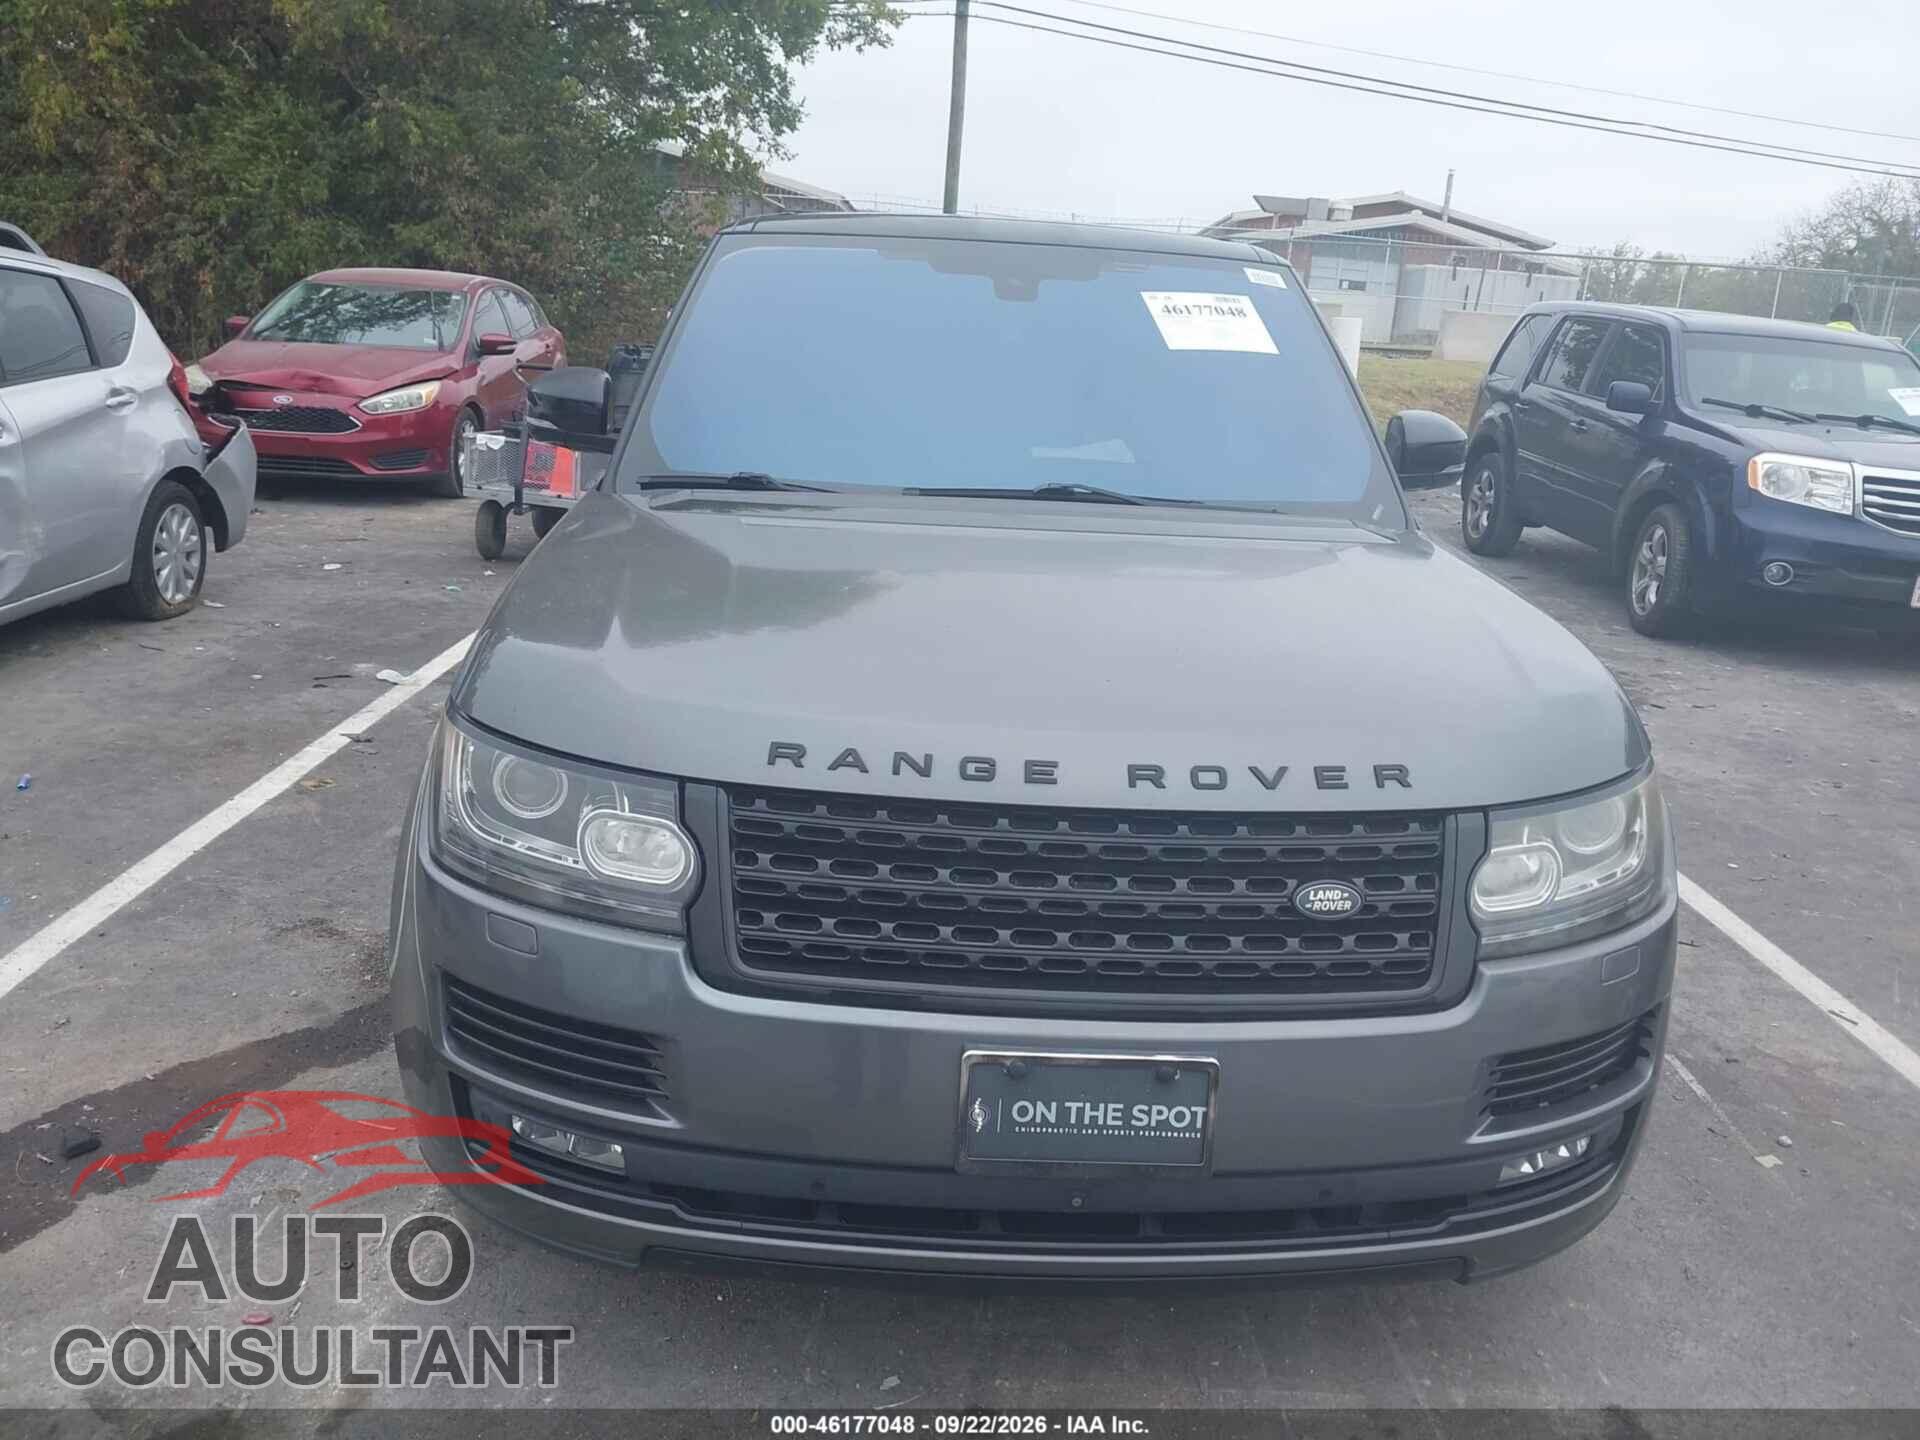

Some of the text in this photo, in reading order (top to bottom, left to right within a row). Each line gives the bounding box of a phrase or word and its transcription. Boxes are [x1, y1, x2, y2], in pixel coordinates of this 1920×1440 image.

[1161, 303, 1248, 319] 46177048
[767, 741, 1412, 791] RANGE ROVER
[1011, 1100, 1207, 1130] ON THE SPOT
